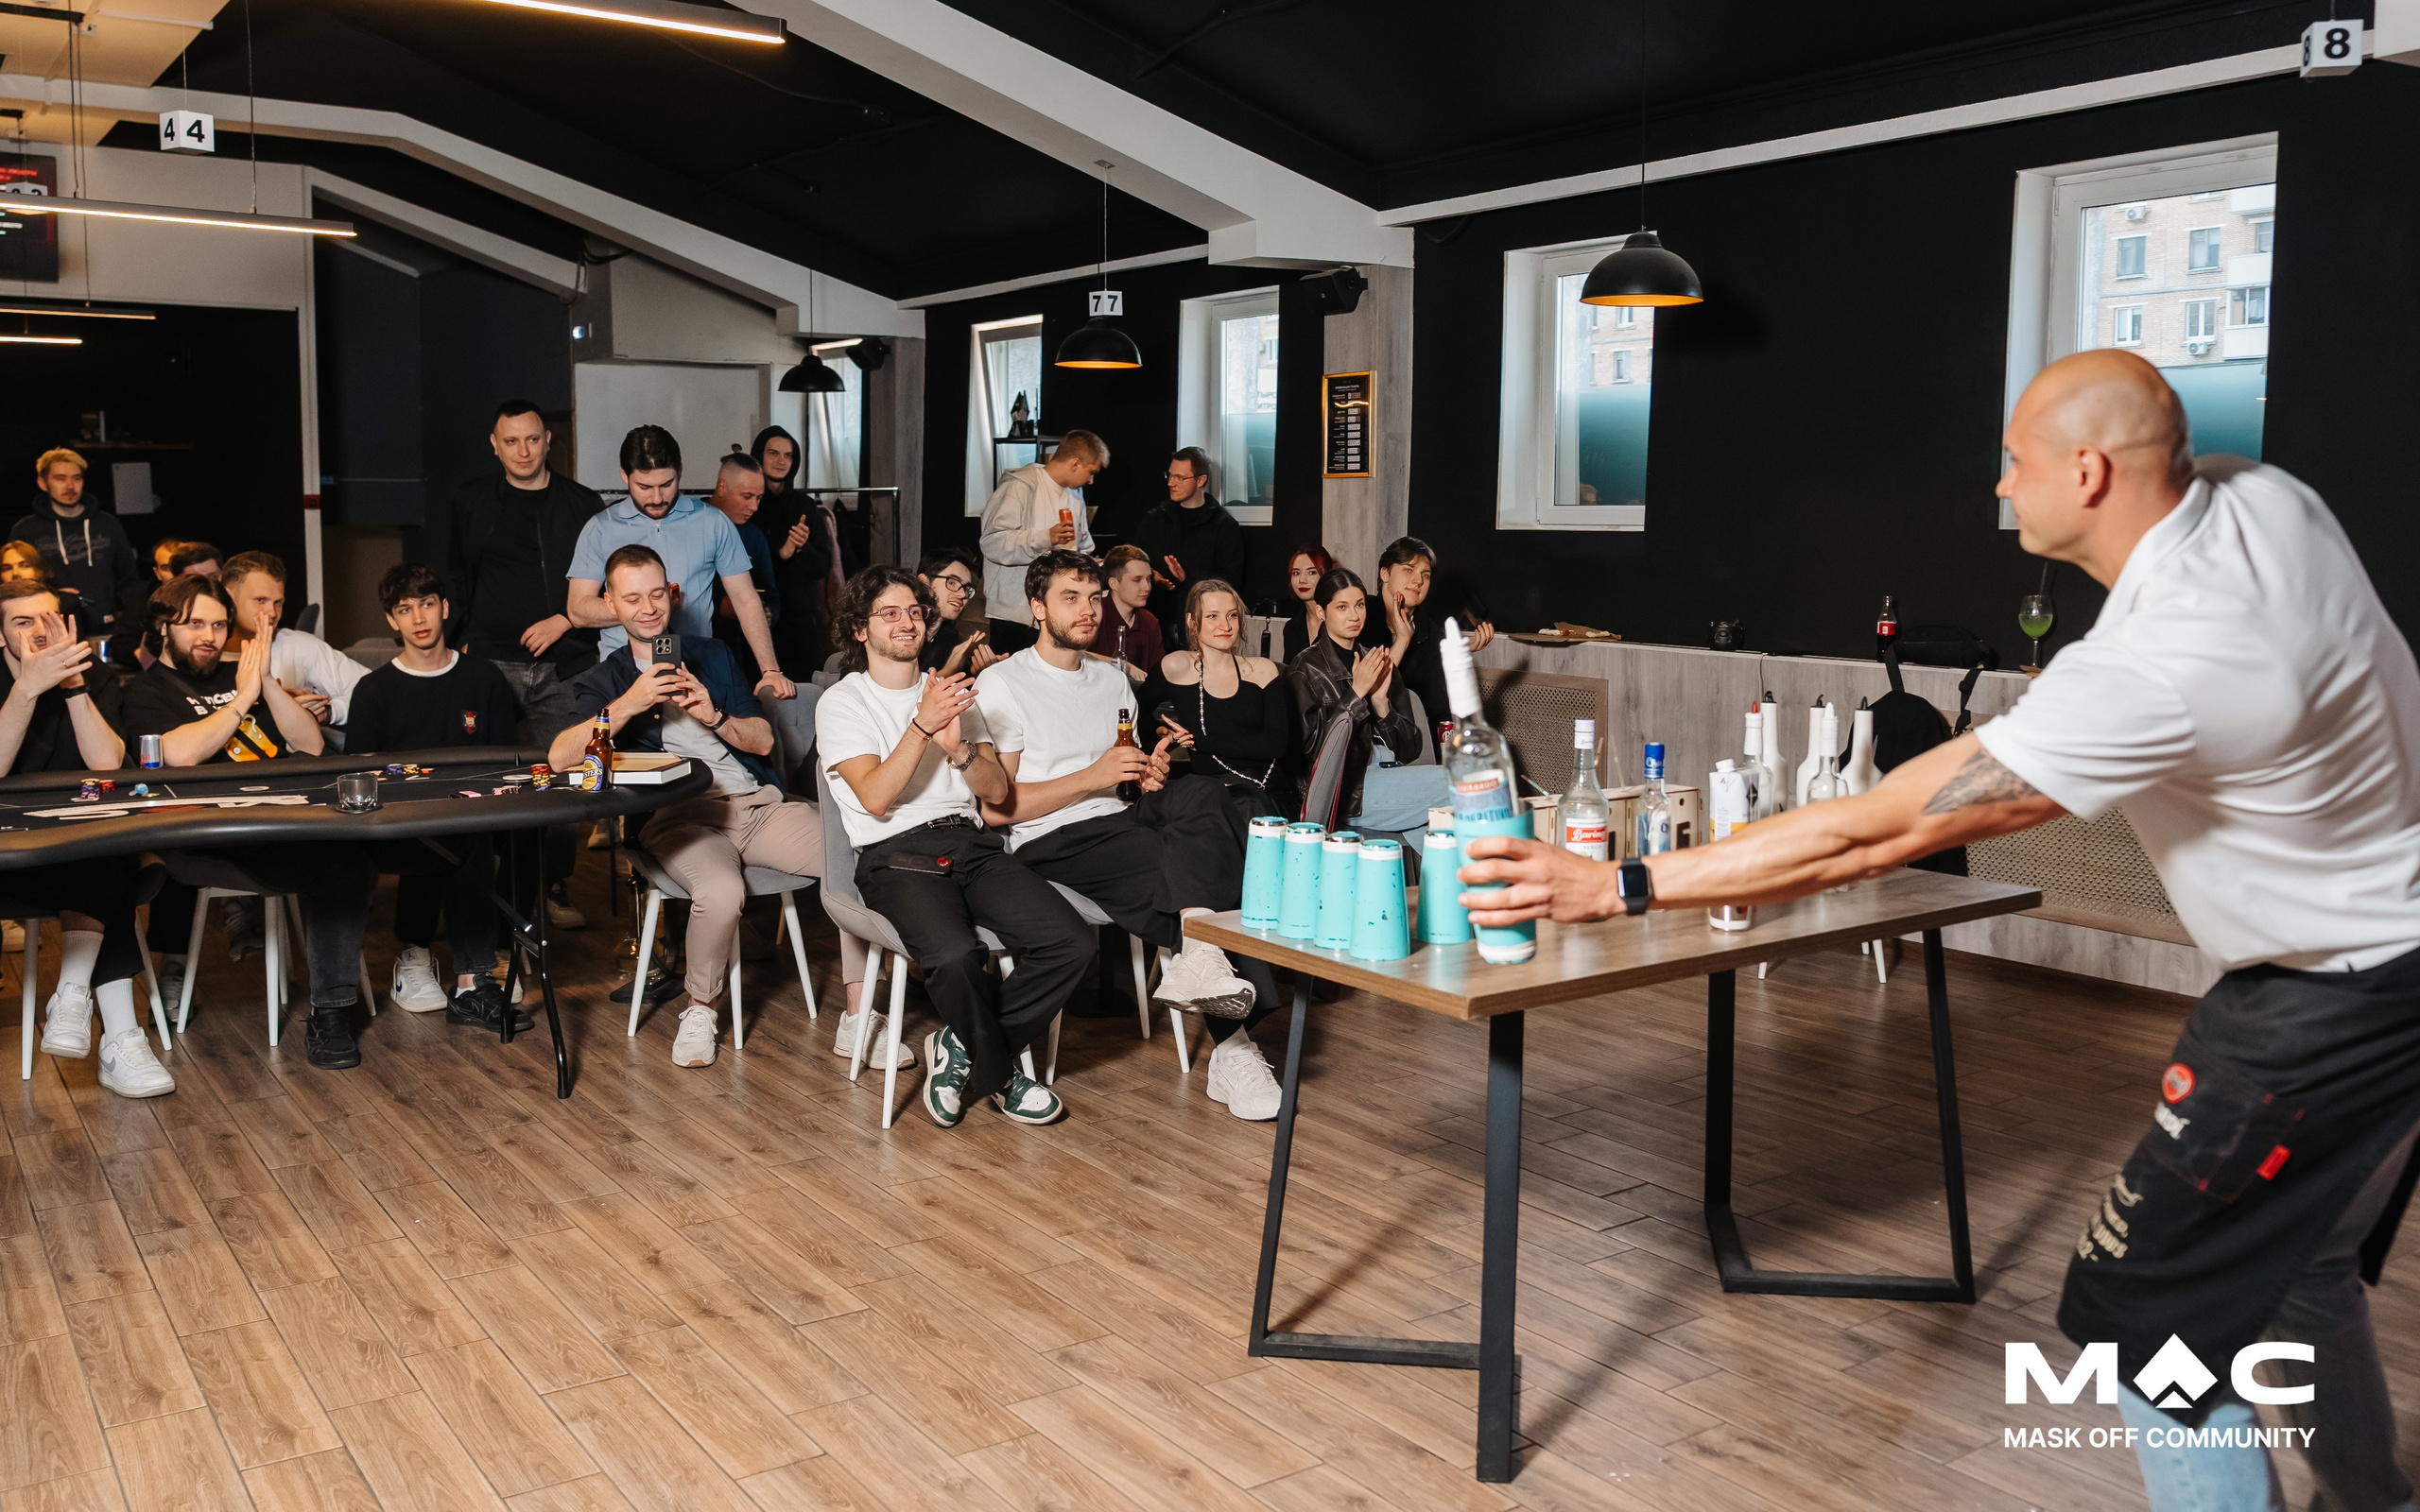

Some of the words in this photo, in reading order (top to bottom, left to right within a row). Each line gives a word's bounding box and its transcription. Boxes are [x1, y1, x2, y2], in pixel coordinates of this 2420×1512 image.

[2325, 27, 2350, 60] 8
[164, 118, 175, 141] 4
[186, 119, 205, 143] 4
[1093, 295, 1101, 312] 7
[1107, 294, 1118, 312] 7
